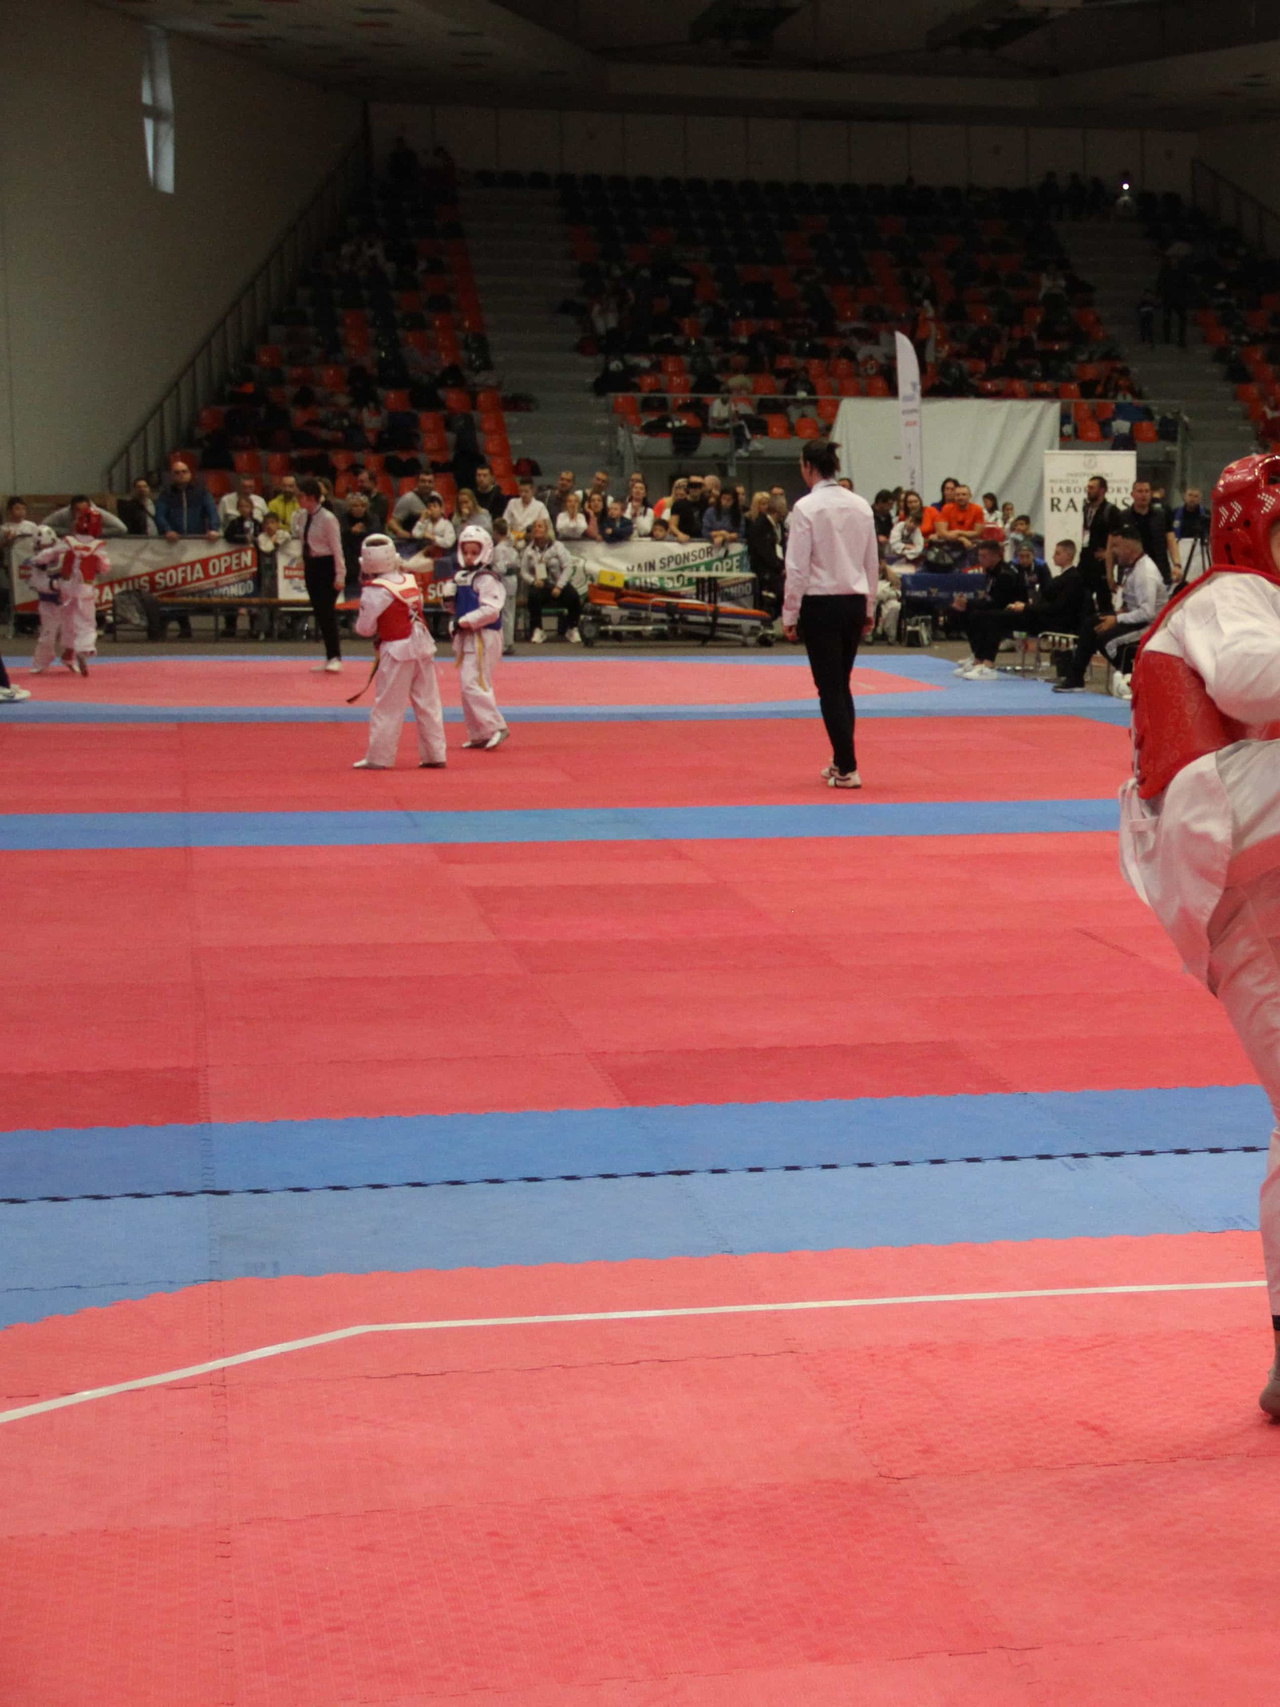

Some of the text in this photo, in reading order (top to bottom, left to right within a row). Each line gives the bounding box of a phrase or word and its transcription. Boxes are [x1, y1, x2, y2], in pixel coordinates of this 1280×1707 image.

[154, 560, 205, 590] SOFIA
[208, 550, 253, 576] OPEN
[660, 546, 714, 570] SPONSOR
